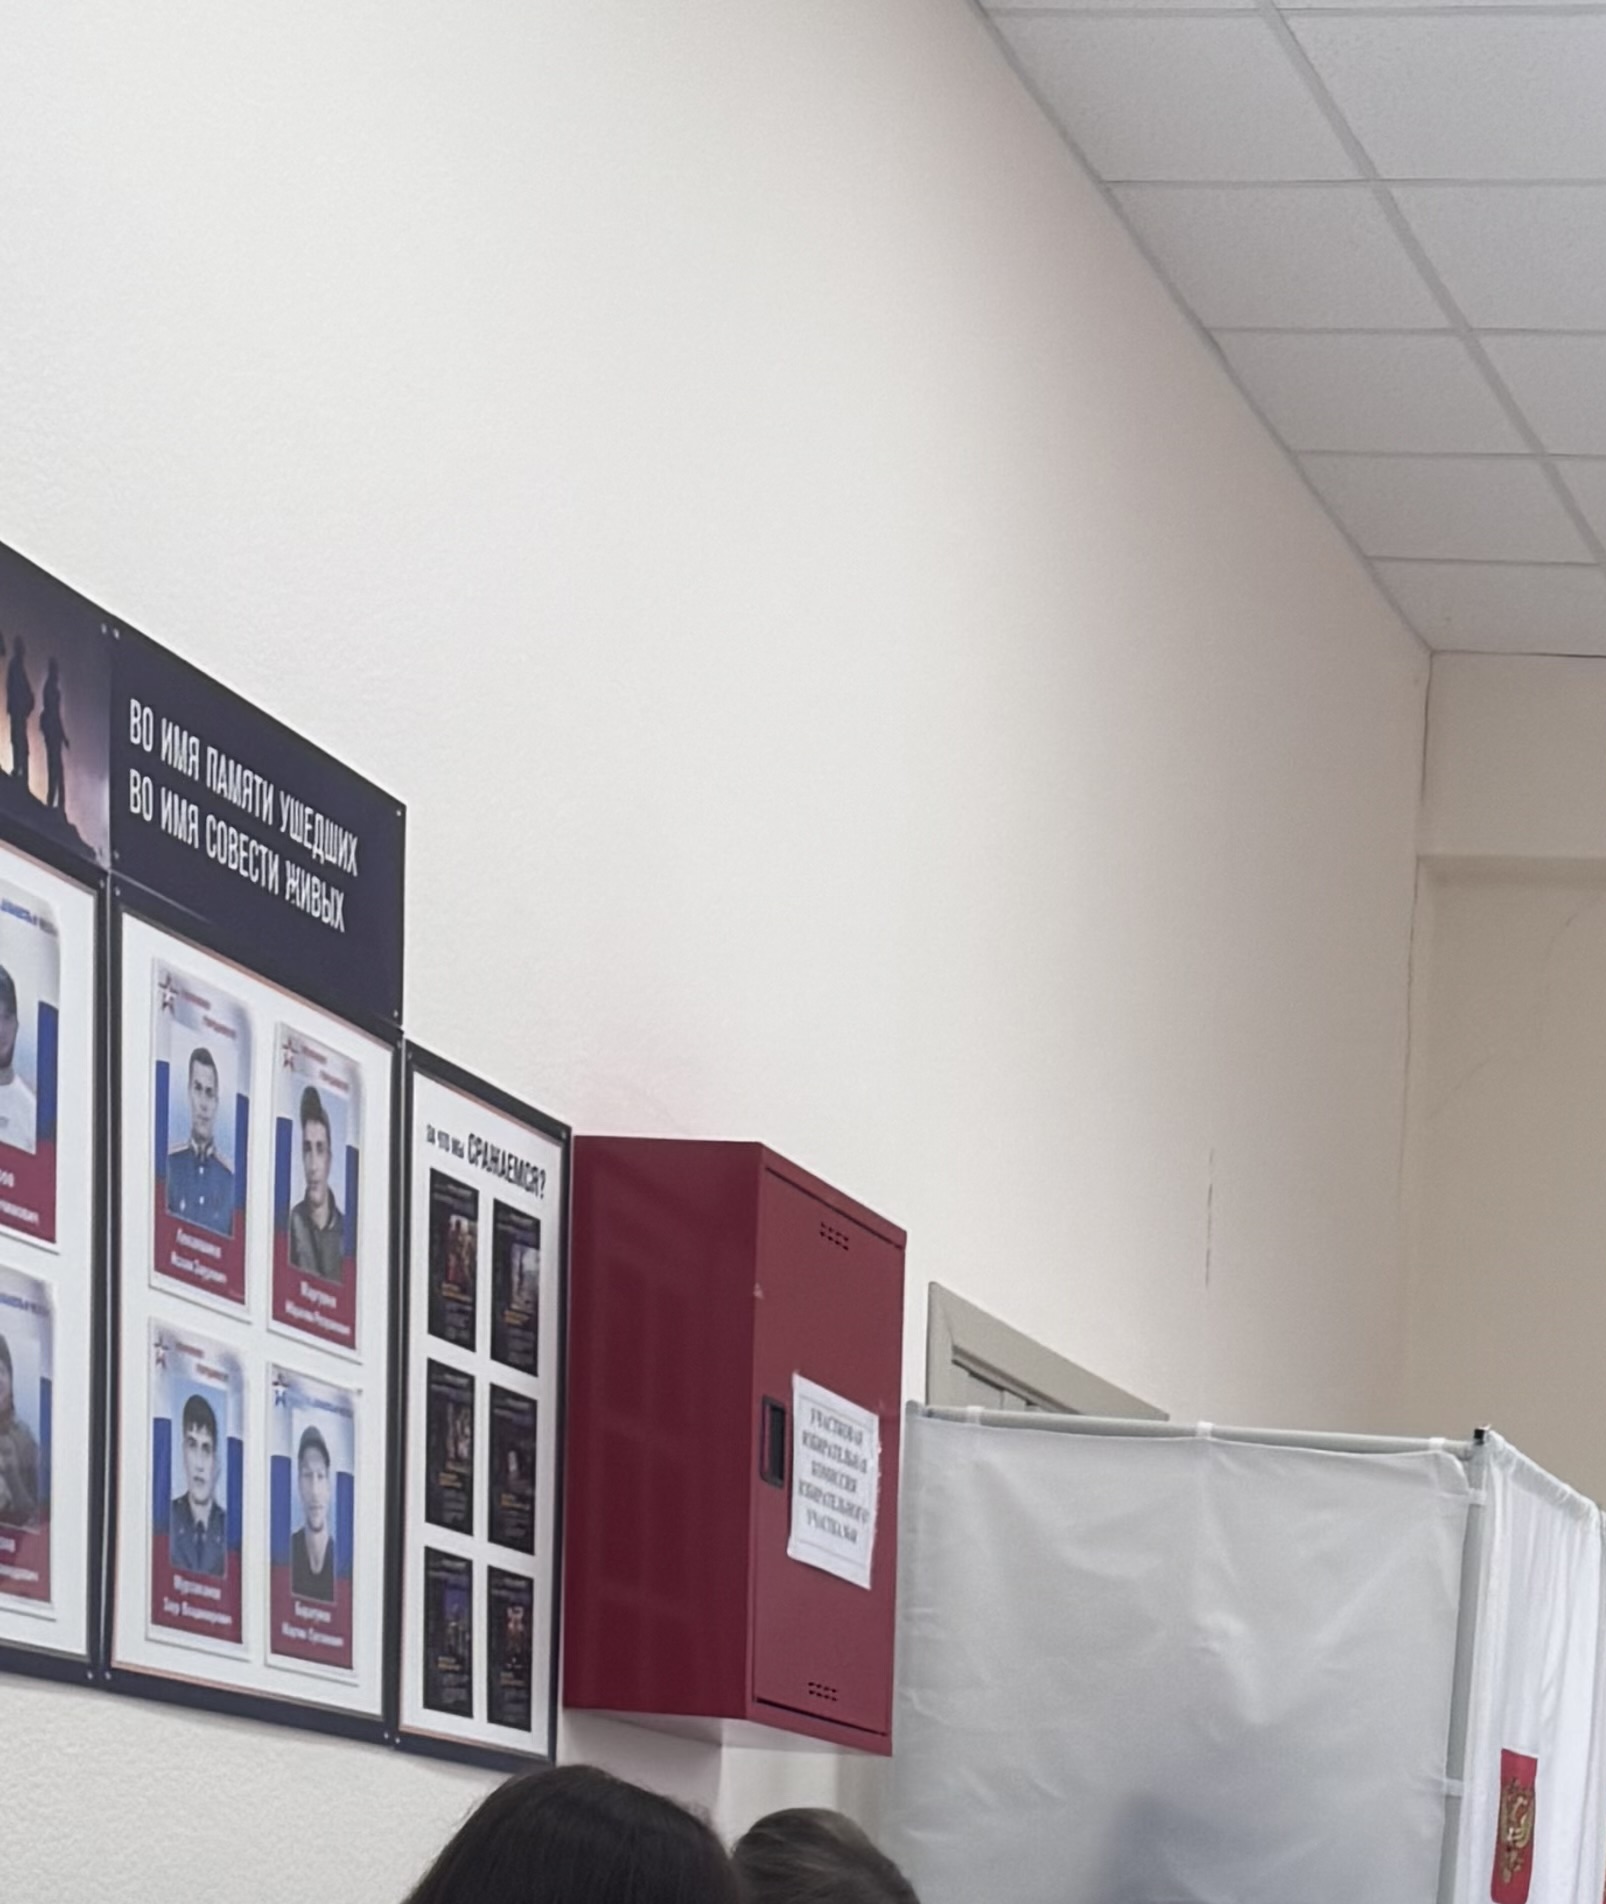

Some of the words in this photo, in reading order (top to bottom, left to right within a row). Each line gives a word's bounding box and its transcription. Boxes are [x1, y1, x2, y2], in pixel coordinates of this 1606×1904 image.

[129, 698, 154, 752] ВО
[160, 717, 200, 781] ИМЯ
[206, 745, 275, 826] ПАМЯТИ
[279, 789, 359, 877] УШЕДШИХ
[129, 768, 154, 822] ВО
[160, 786, 199, 849] ИМЯ
[205, 814, 280, 895] СОВЕСТИ
[284, 860, 346, 933] ЖИВЫХ
[467, 1132, 547, 1200] СРАЖАЕМСЯ?
